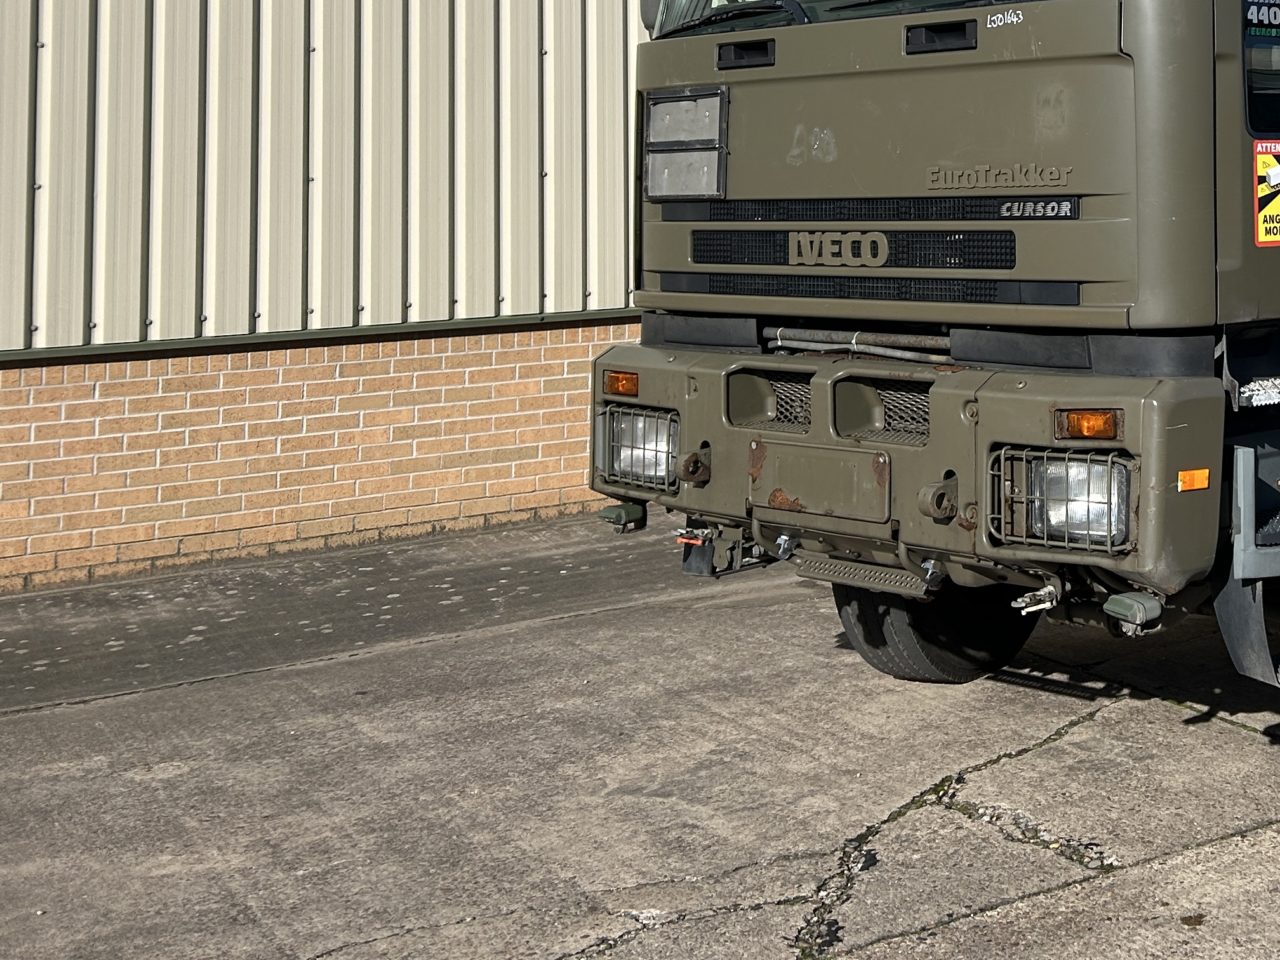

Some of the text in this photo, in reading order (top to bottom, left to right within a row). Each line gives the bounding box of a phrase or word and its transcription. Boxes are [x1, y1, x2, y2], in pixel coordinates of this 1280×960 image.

[926, 162, 1073, 190] EuroTrakker
[1000, 201, 1072, 217] CURSOR
[788, 230, 889, 267] IVECO
